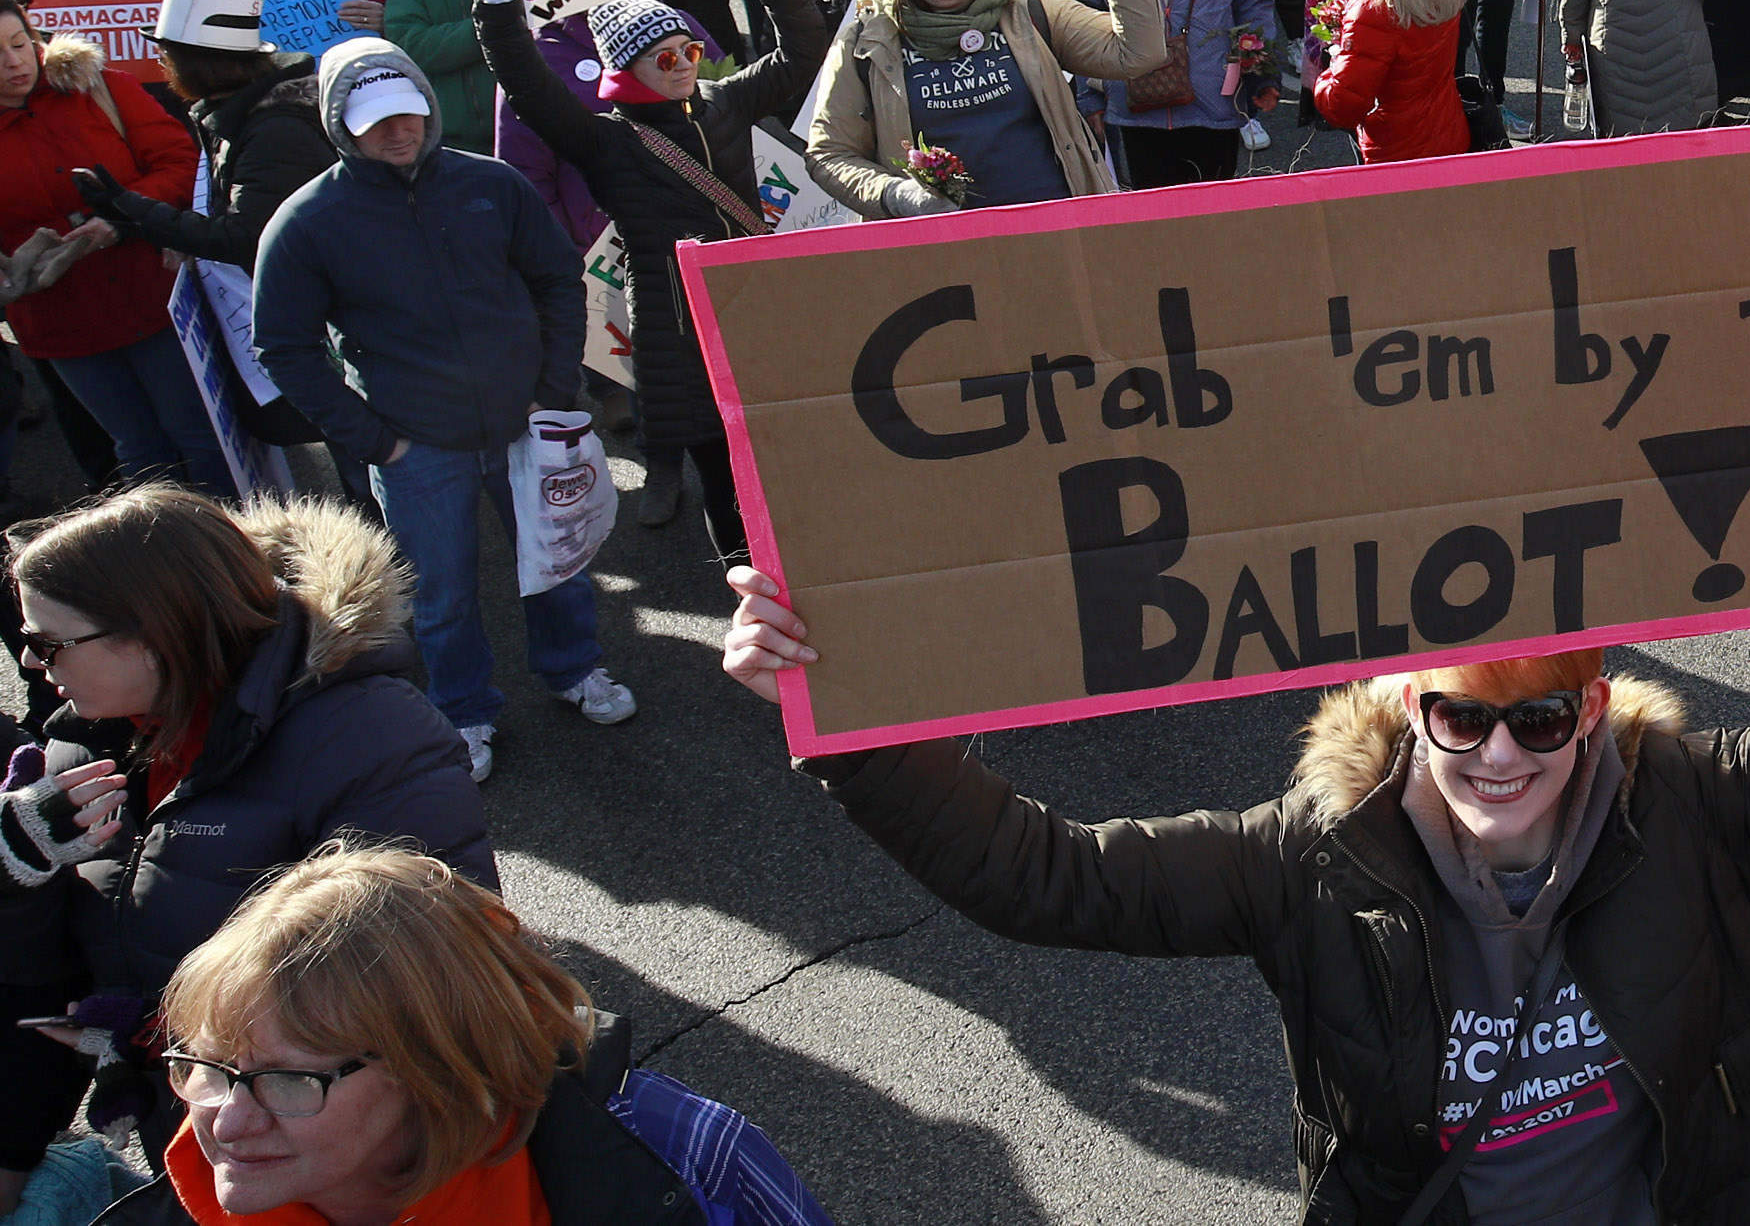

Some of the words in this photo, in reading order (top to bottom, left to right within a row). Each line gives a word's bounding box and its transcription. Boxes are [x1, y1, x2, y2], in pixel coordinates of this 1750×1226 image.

[31, 6, 160, 28] OBAMACAR
[920, 68, 1010, 100] DELAWARE
[930, 68, 941, 80] 18
[926, 93, 971, 110] ENDLESS
[972, 82, 1013, 106] SUMMER
[852, 284, 1234, 461] Grab
[1327, 295, 1496, 406] 'em
[1548, 247, 1670, 430] by
[547, 467, 588, 492] Jewel
[551, 482, 589, 502] Osco
[172, 820, 227, 836] Marmot
